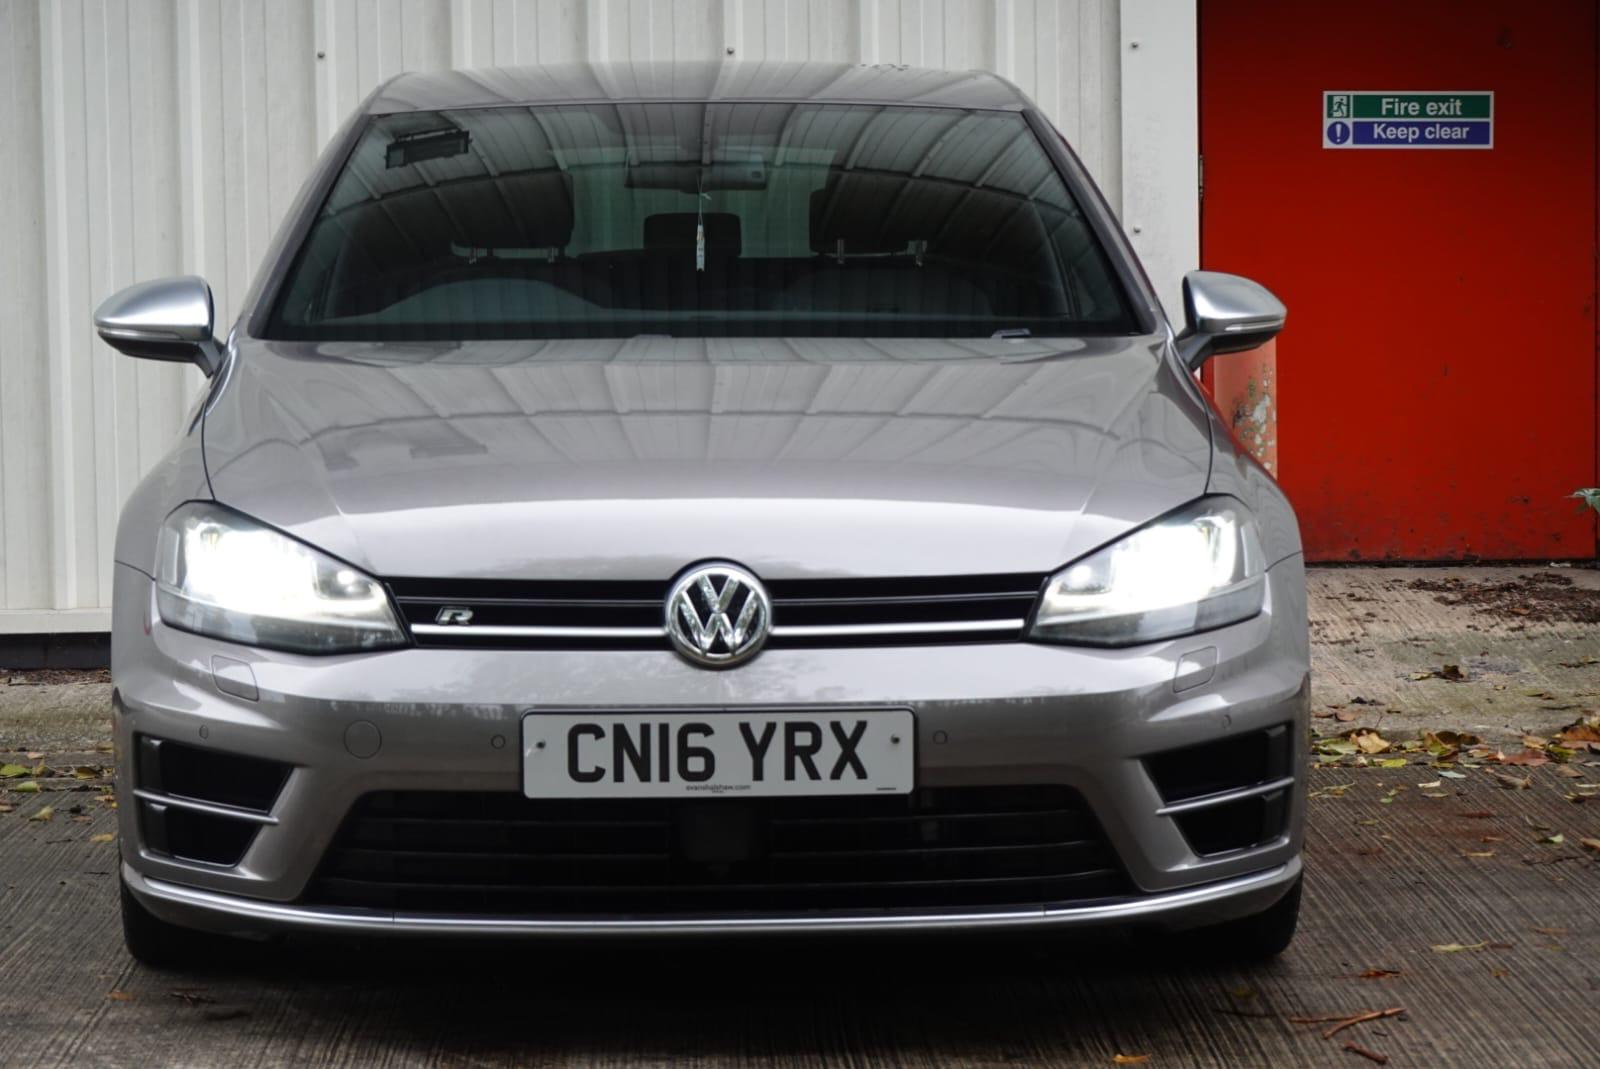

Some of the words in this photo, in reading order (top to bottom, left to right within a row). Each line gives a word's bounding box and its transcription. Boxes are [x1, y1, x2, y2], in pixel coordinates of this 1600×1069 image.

[1381, 98, 1420, 116] Fire
[1426, 98, 1462, 116] exit
[1373, 123, 1419, 143] Keep
[1424, 123, 1470, 139] clear
[435, 606, 474, 625] R
[567, 722, 716, 783] CN16
[738, 720, 868, 782] YRX
